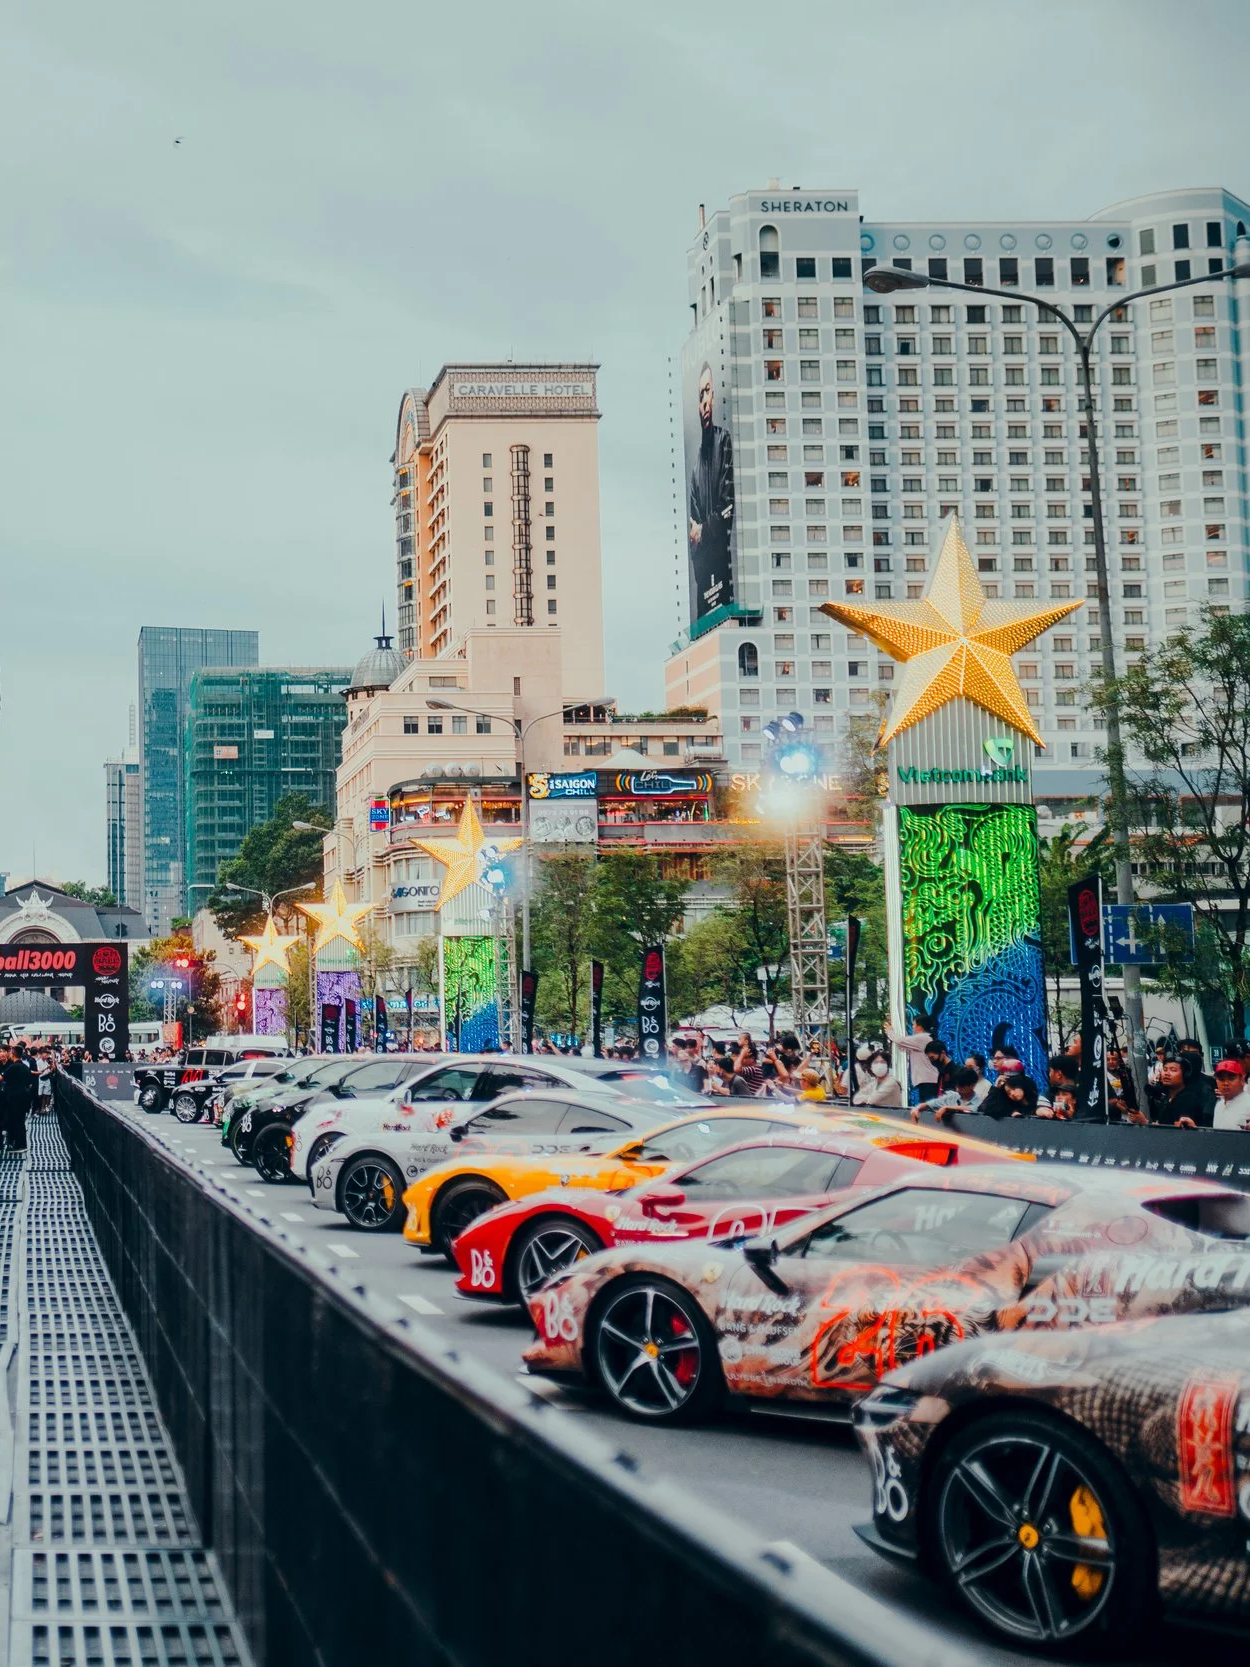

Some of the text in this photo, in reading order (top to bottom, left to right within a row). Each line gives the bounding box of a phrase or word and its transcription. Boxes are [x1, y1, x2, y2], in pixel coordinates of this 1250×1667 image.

[761, 201, 848, 212] SHERATON
[458, 385, 589, 396] CARAVELLE HOTEL
[555, 779, 595, 789] SAIGON
